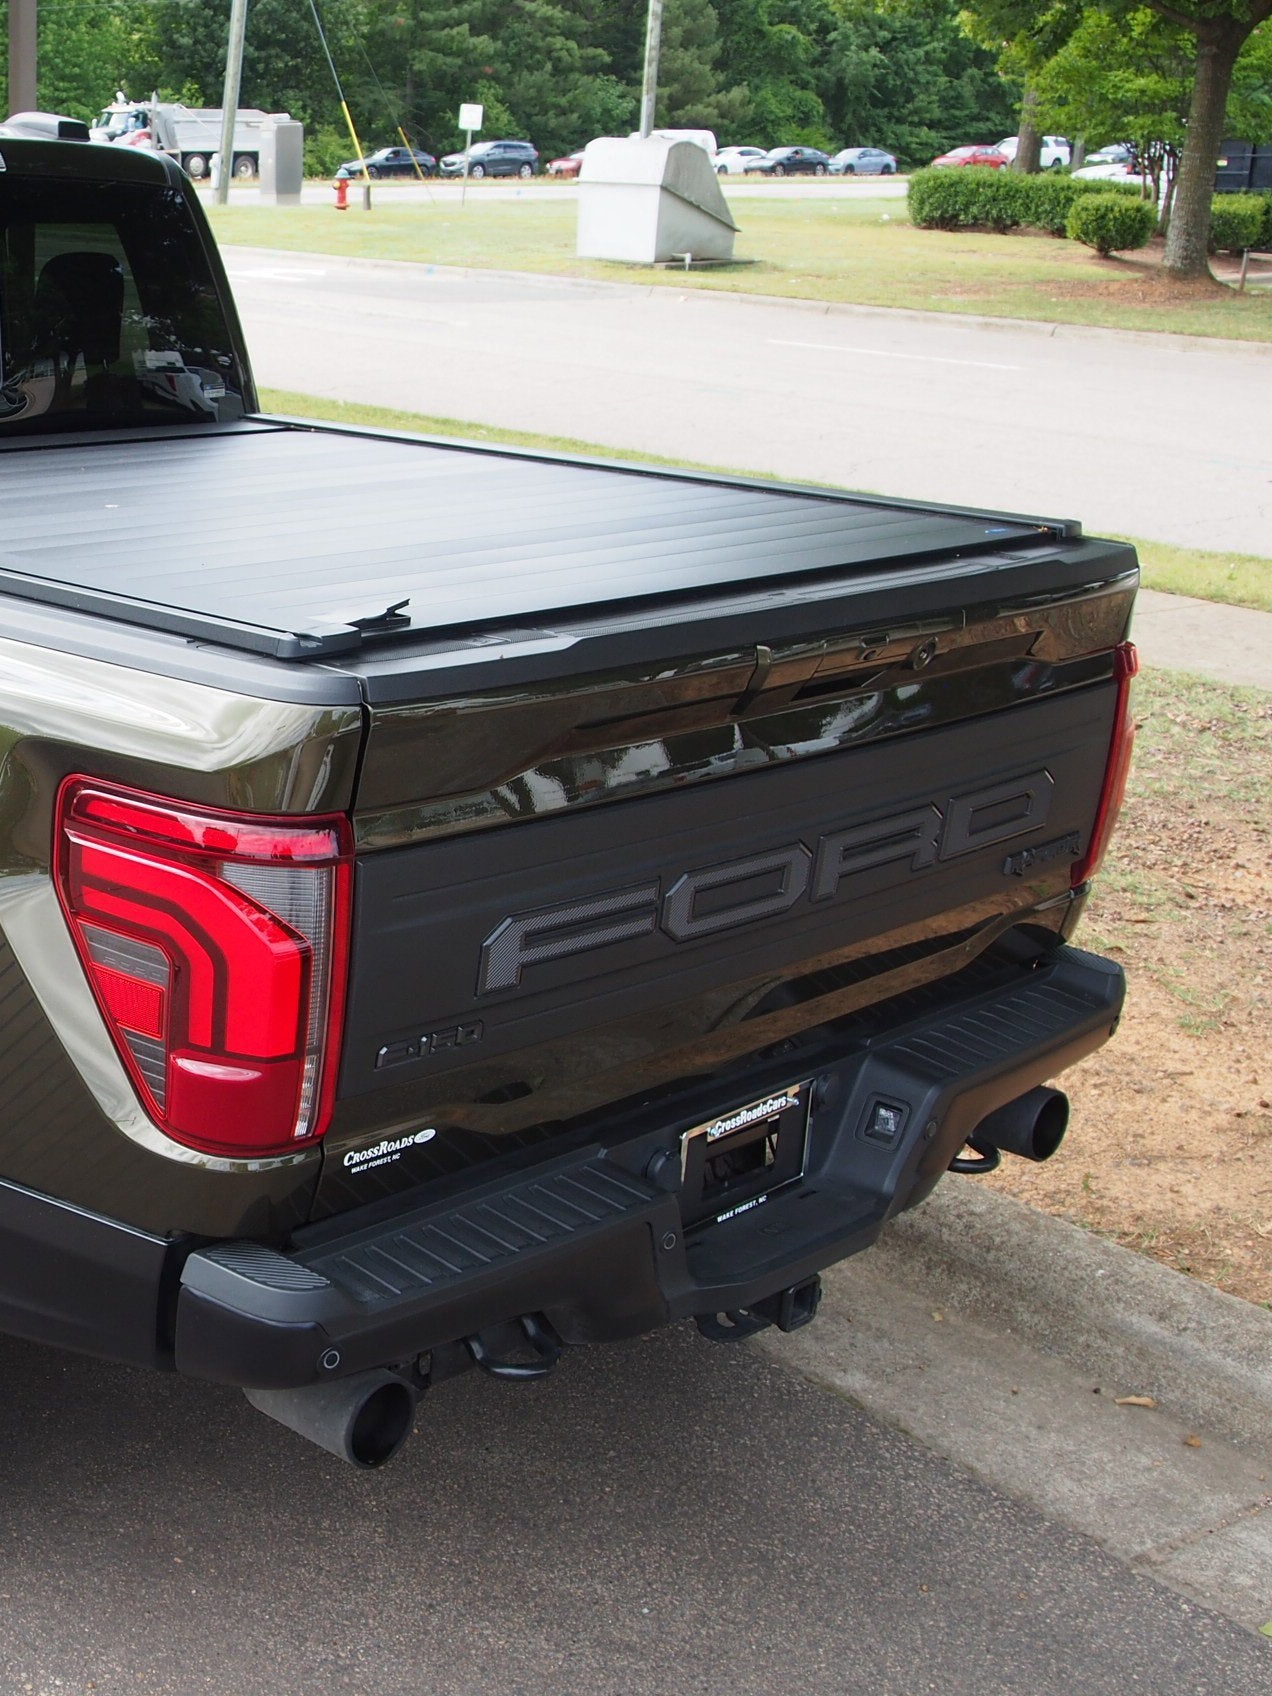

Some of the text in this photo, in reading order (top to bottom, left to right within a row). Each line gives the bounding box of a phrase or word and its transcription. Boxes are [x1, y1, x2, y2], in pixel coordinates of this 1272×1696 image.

[475, 768, 1055, 1000] FORD
[351, 1163, 368, 1174] WAKE
[391, 1153, 401, 1161] NC
[717, 1209, 735, 1223] WAKE
[758, 1195, 768, 1205] NC
